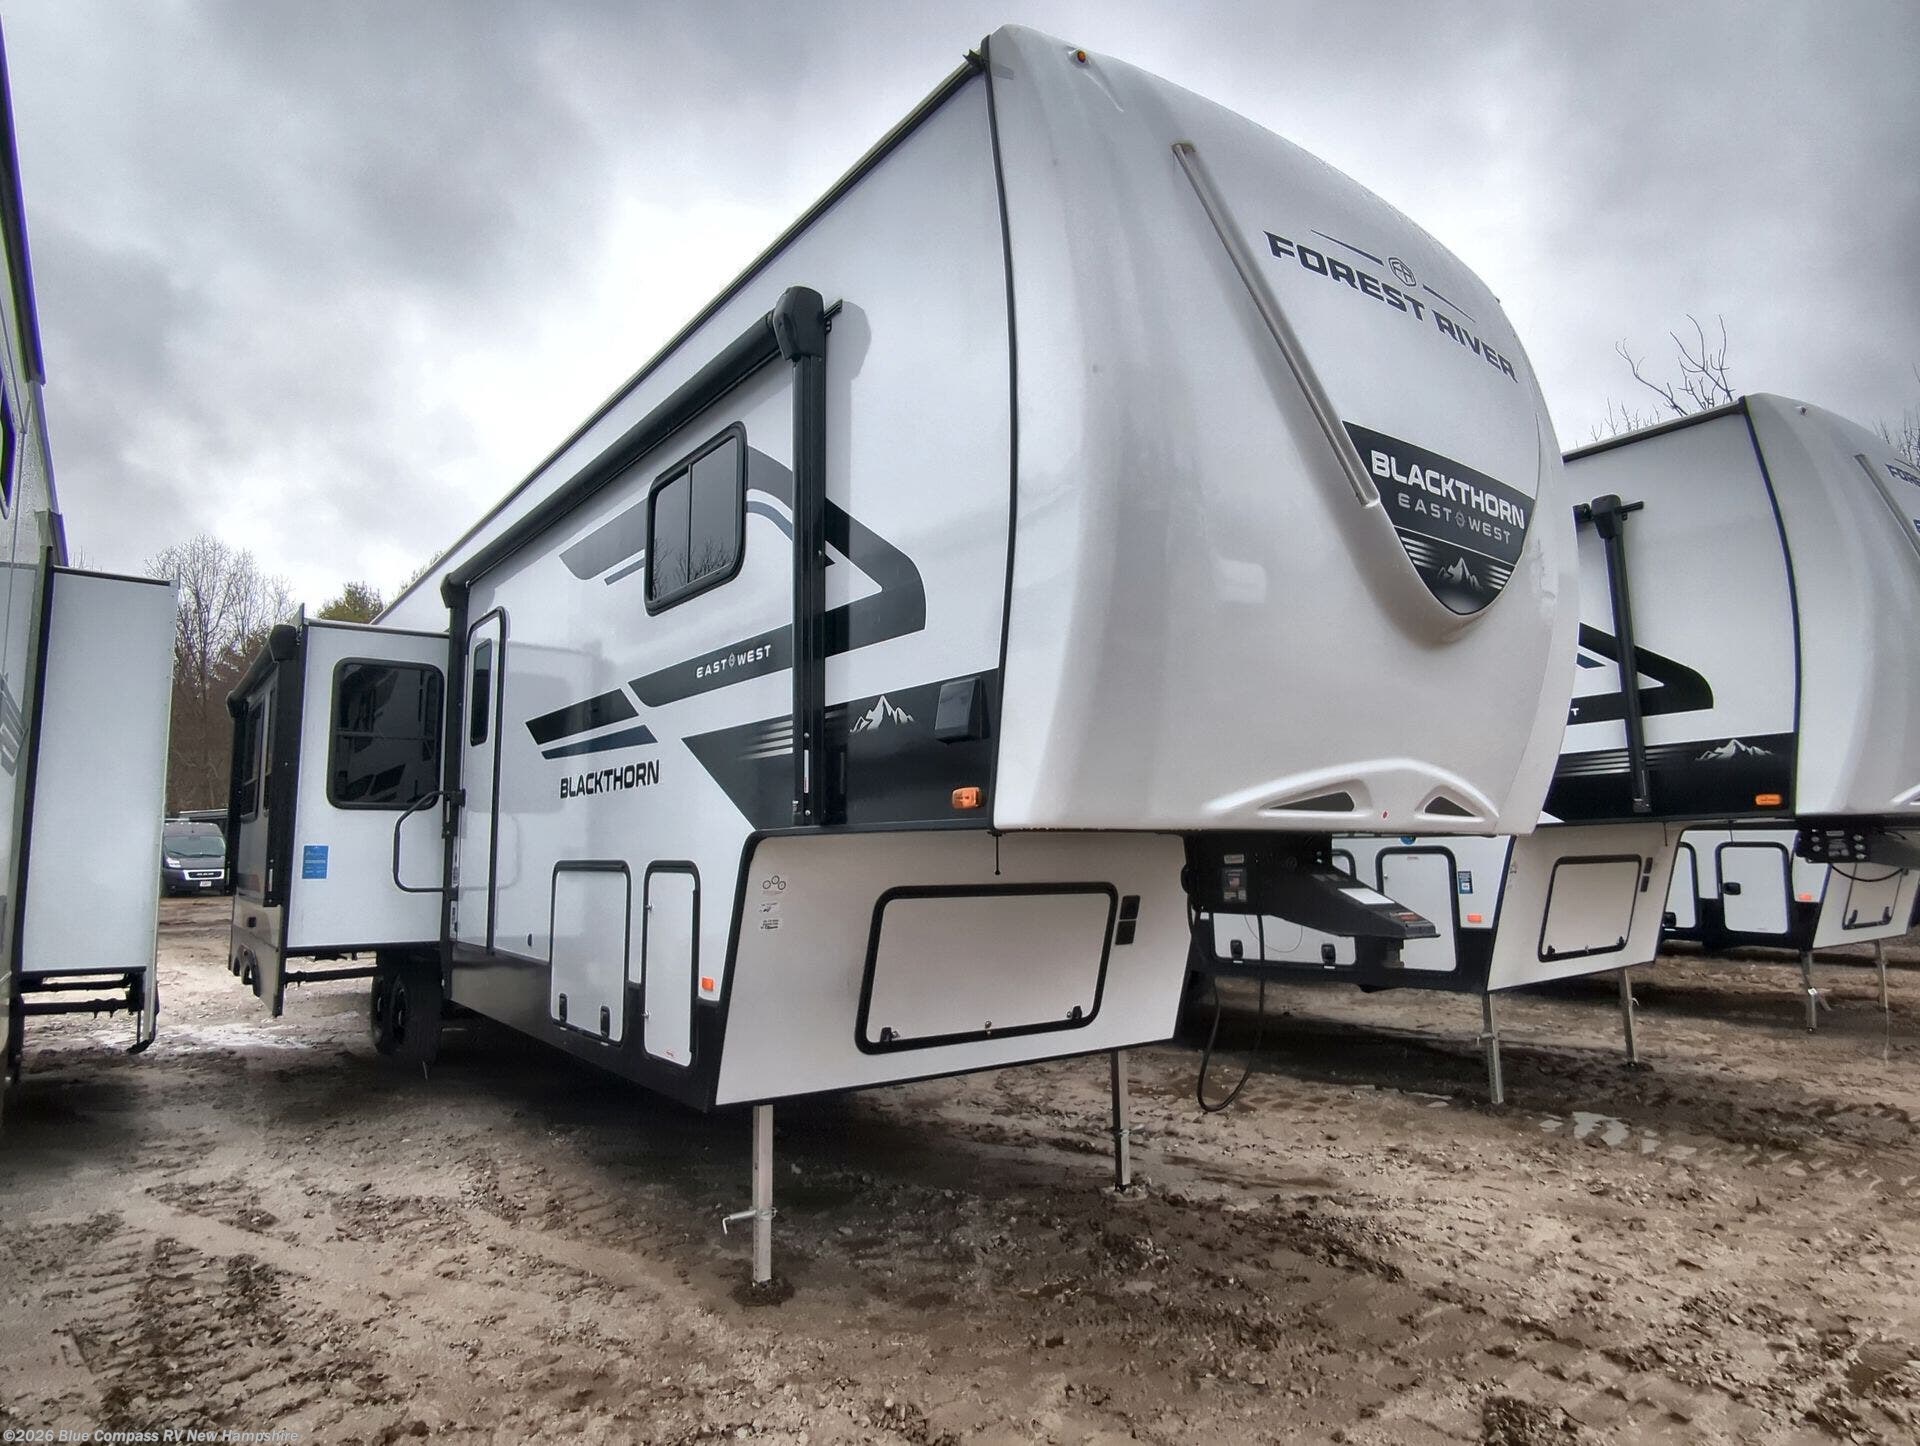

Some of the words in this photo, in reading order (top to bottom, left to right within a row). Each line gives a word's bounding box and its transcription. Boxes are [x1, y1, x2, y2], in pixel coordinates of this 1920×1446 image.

[1263, 230, 1425, 321] FOREST
[1431, 309, 1518, 383] RIVER
[1371, 450, 1525, 530] BLACKTHORN
[1398, 492, 1451, 522] EAST
[1467, 516, 1511, 544] WEST
[696, 659, 727, 678] EAST
[737, 644, 771, 666] WEST
[560, 759, 659, 799] BLACKTHORN
